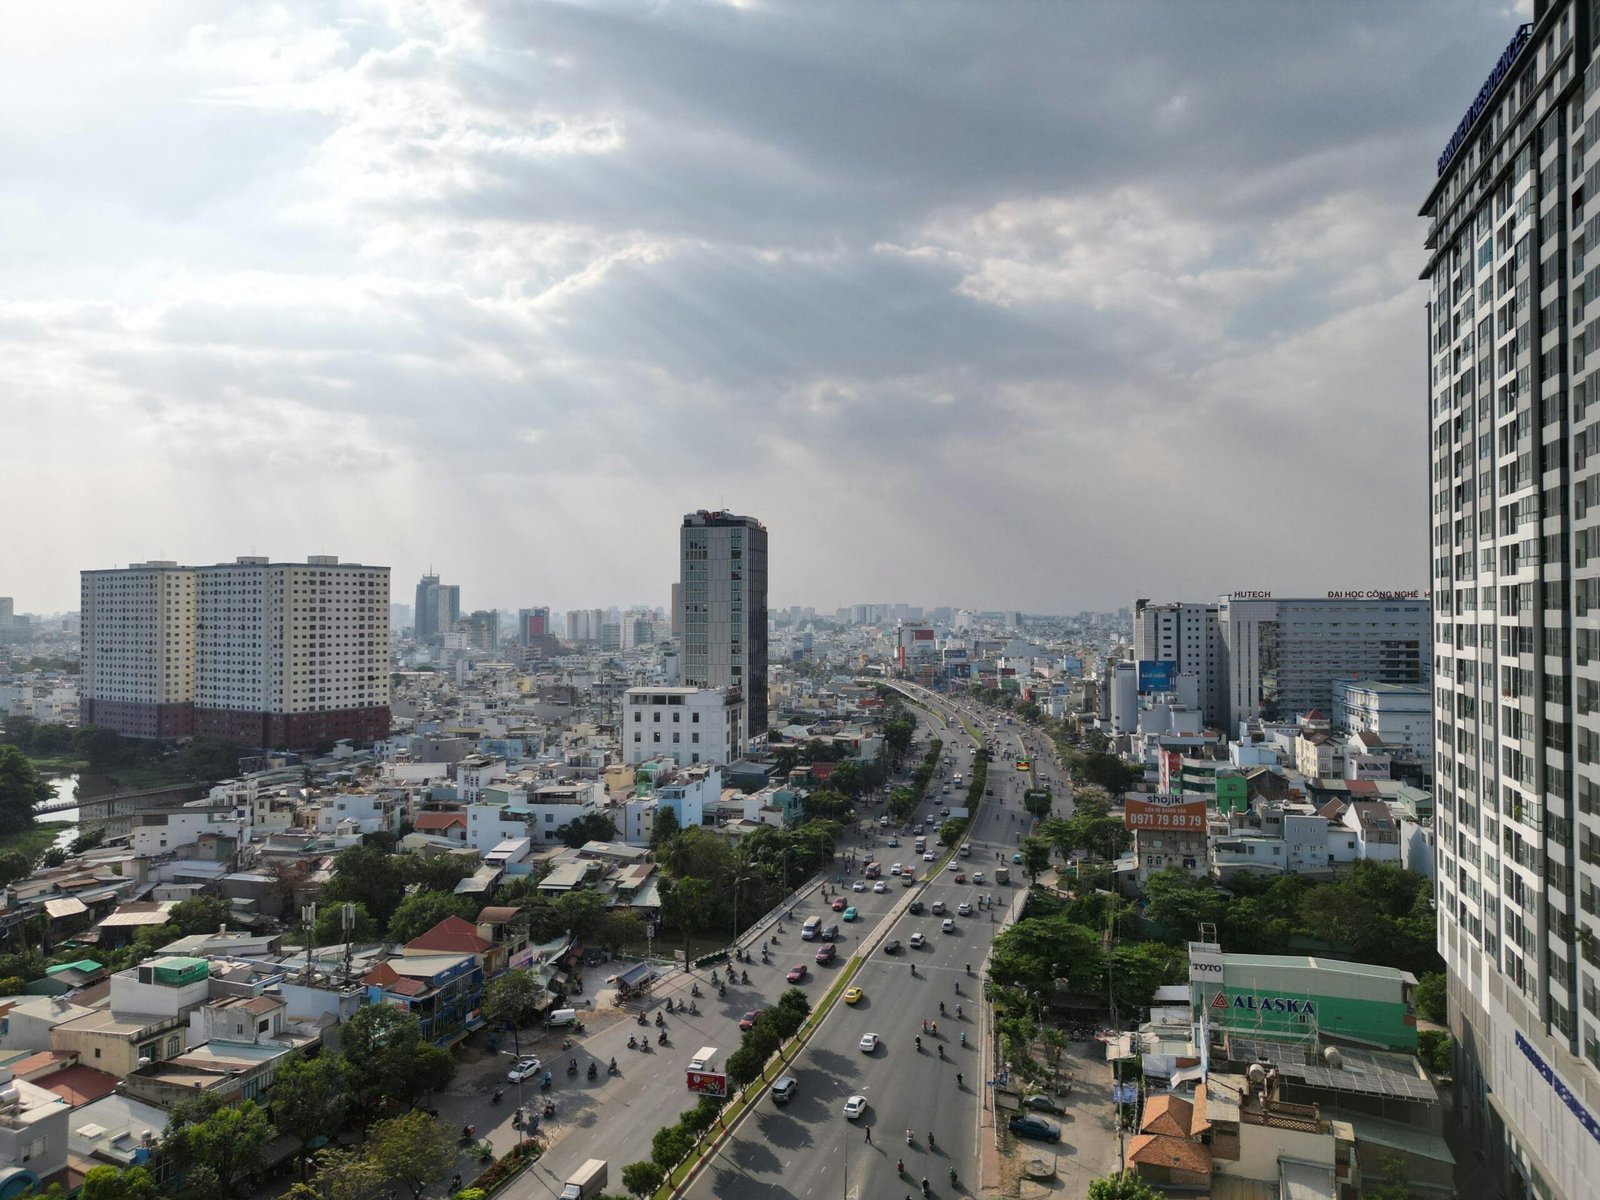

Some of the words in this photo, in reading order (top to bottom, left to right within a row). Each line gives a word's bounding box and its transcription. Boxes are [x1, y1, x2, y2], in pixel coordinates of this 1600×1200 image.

[1437, 105, 1473, 177] PARKVIEW
[1366, 588, 1393, 598] CÔNG
[1147, 795, 1184, 806] shojiki
[1130, 813, 1154, 825] 0971
[1157, 814, 1169, 826] 79
[1172, 815, 1186, 826] 89
[1189, 815, 1202, 827] 79
[1192, 962, 1222, 973] TOTO
[1233, 994, 1315, 1014] ALASKA
